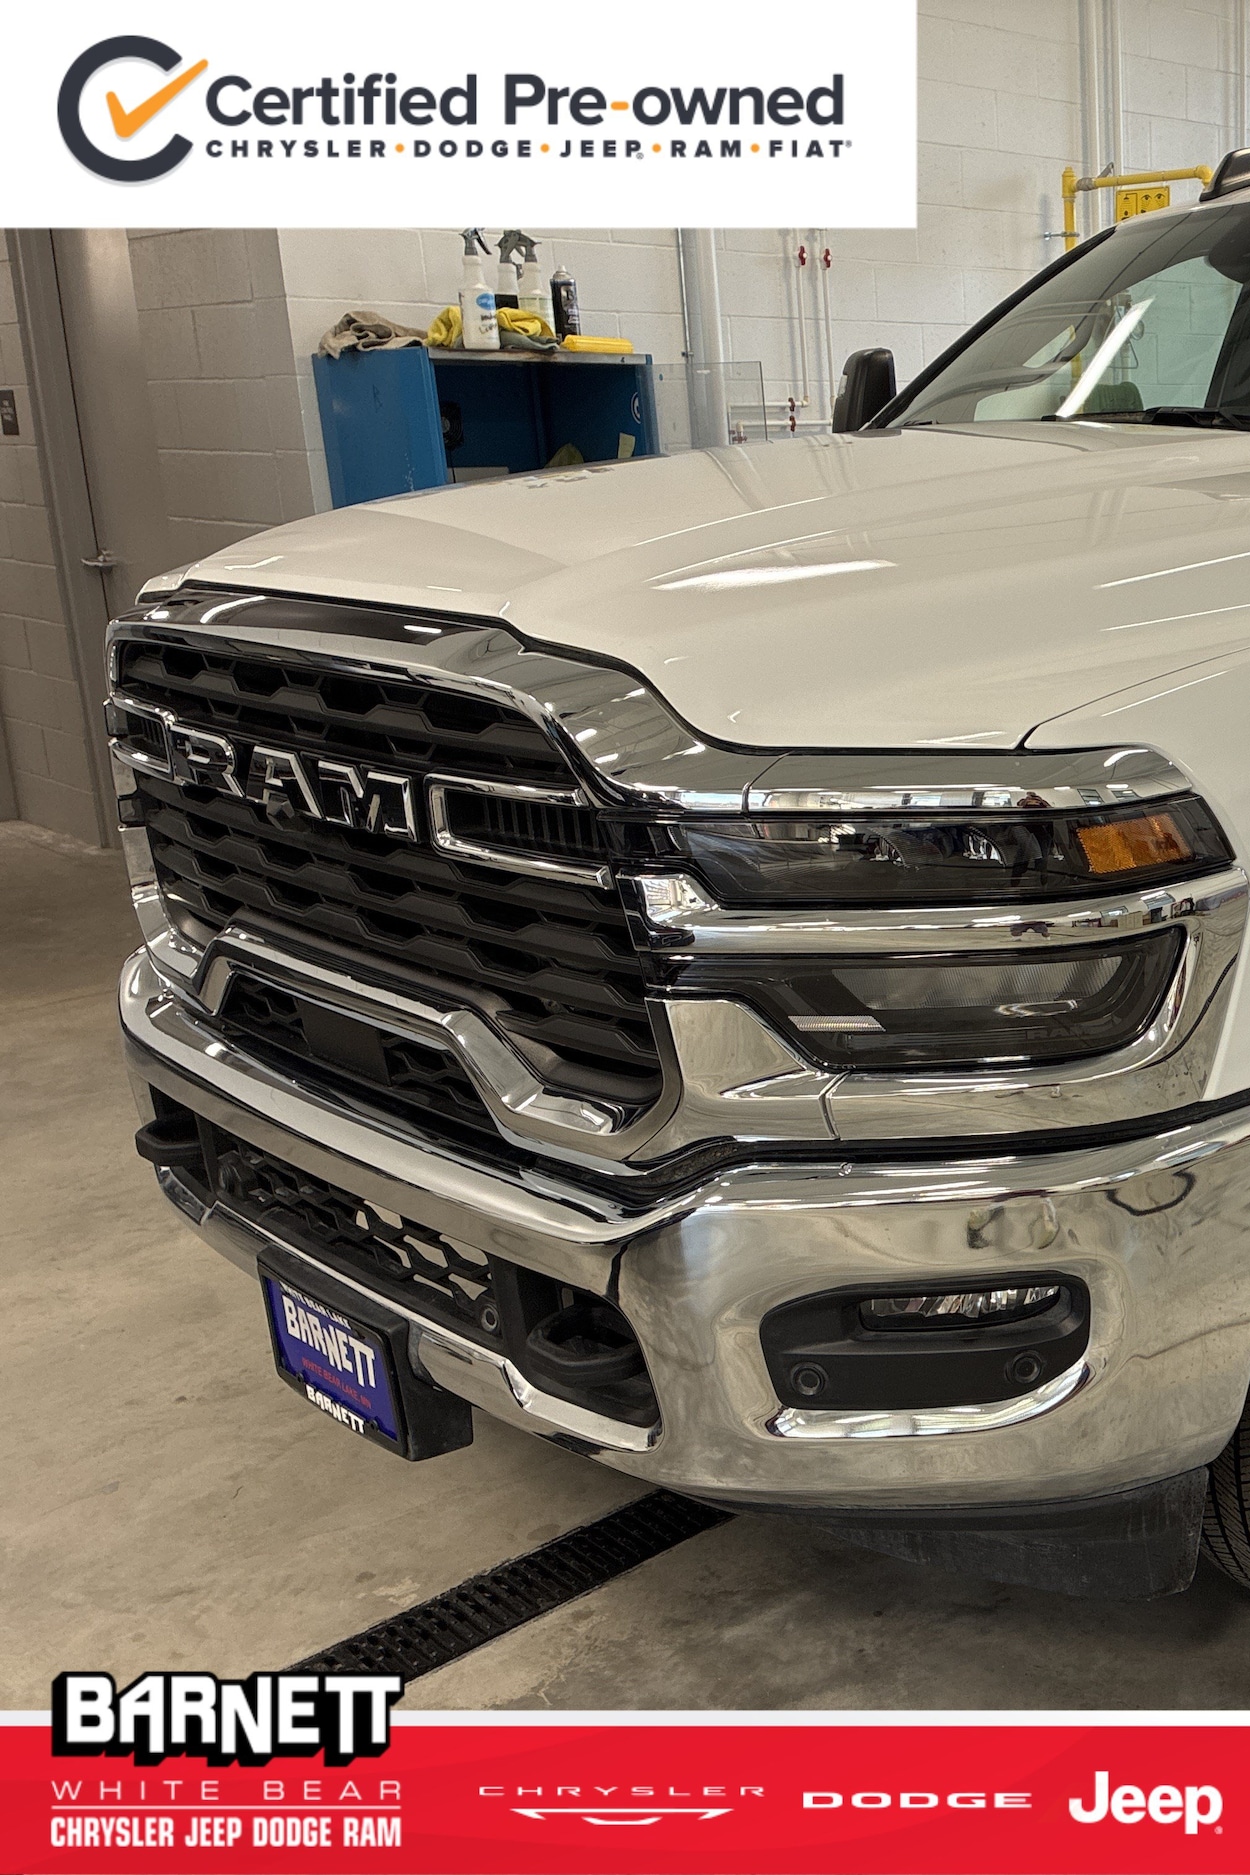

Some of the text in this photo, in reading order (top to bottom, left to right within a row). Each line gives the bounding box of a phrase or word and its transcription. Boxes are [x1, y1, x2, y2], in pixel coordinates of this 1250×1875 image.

[169, 722, 418, 843] RAM
[282, 1295, 376, 1388] BARNETT
[306, 1385, 365, 1434] BARNETT
